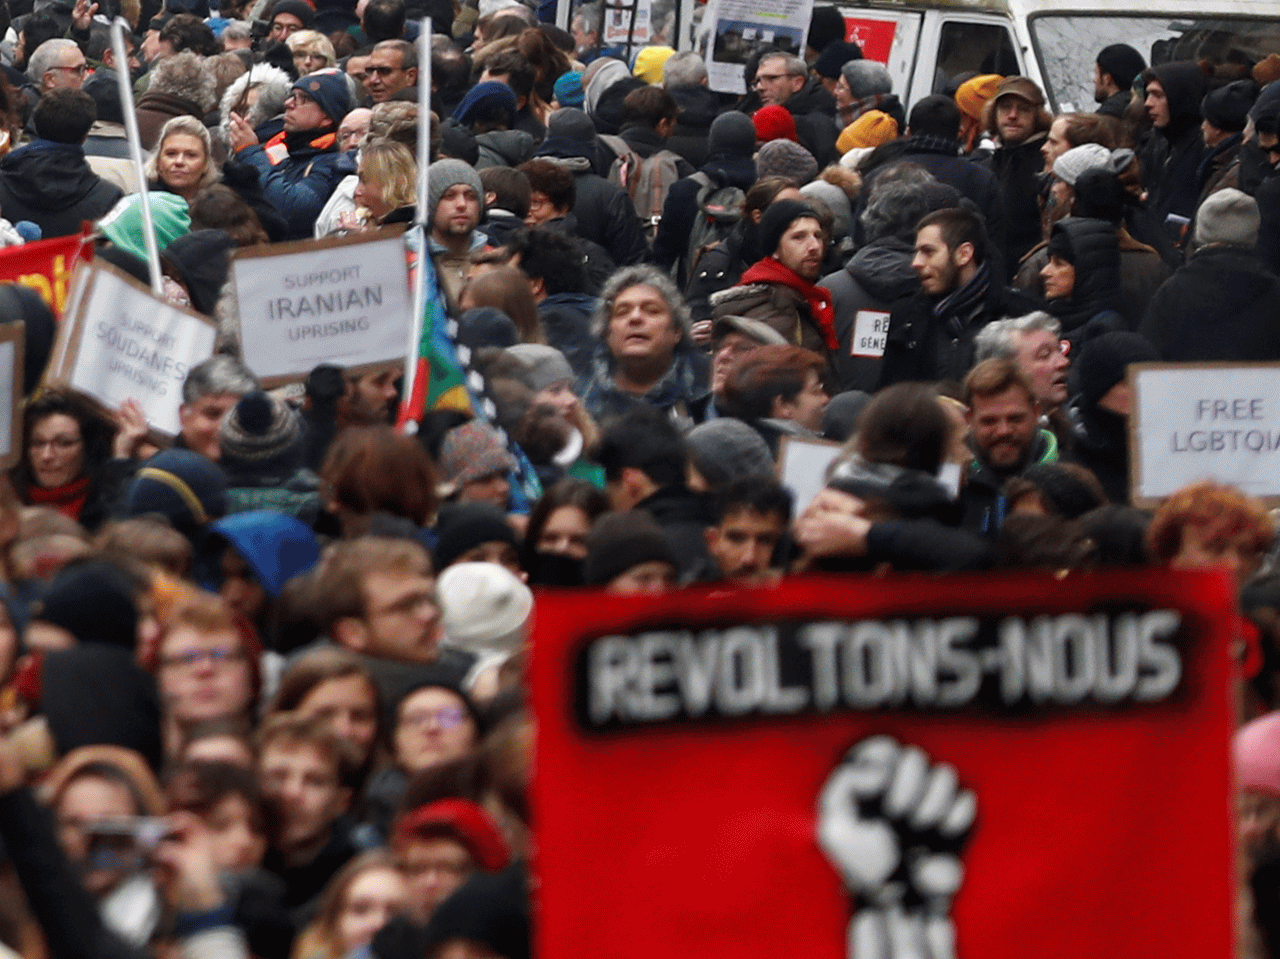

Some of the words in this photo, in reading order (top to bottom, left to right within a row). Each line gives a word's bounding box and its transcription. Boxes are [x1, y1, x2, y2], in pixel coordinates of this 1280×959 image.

[283, 265, 362, 291] SUPPORT
[267, 283, 384, 321] IRANIAN
[117, 311, 177, 349] SUPPORT
[287, 315, 371, 343] UPRISING
[106, 356, 169, 397] UPRISING
[1194, 397, 1265, 423] FREE
[585, 609, 1182, 724] REVOLTONS-NOUS
